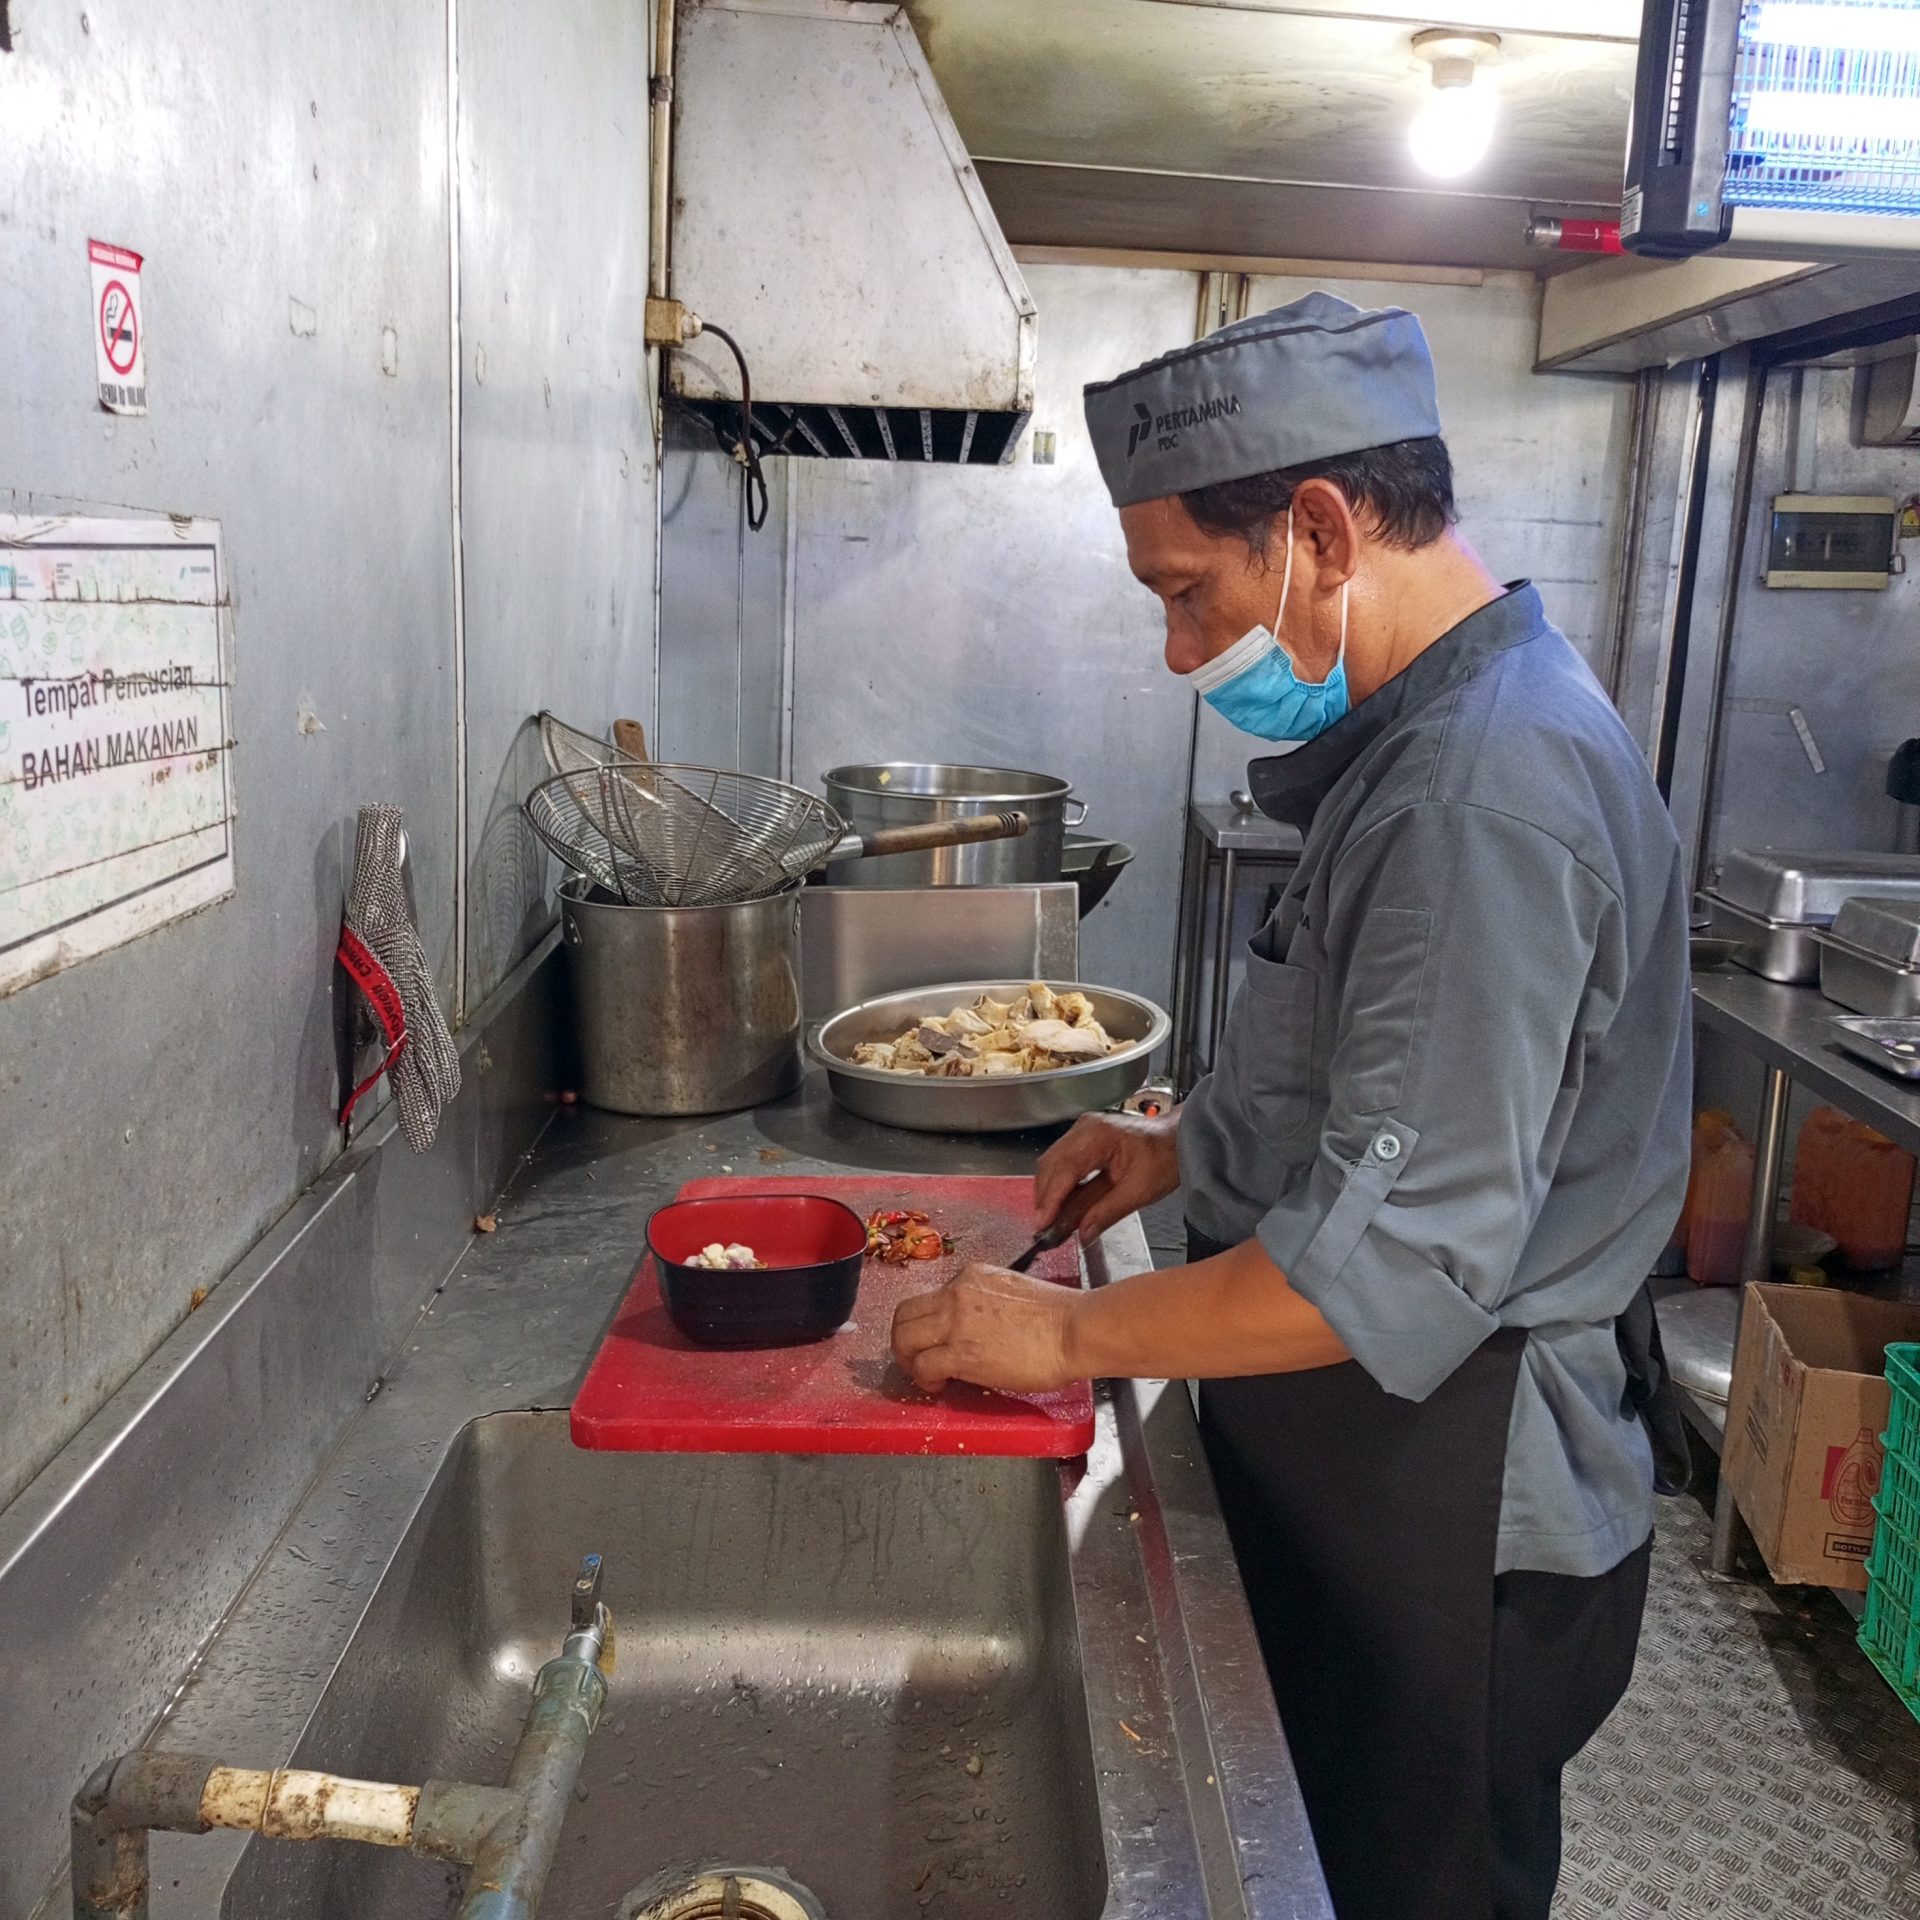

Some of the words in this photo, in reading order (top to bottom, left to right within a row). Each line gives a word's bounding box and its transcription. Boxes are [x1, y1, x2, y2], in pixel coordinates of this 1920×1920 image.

[1155, 394, 1241, 433] PERTAMINA
[1158, 434, 1180, 451] PDC
[20, 679, 98, 720] Tempat
[102, 659, 194, 703] Pencucian
[22, 737, 100, 792] BAHAN
[106, 715, 198, 769] MAKANAN
